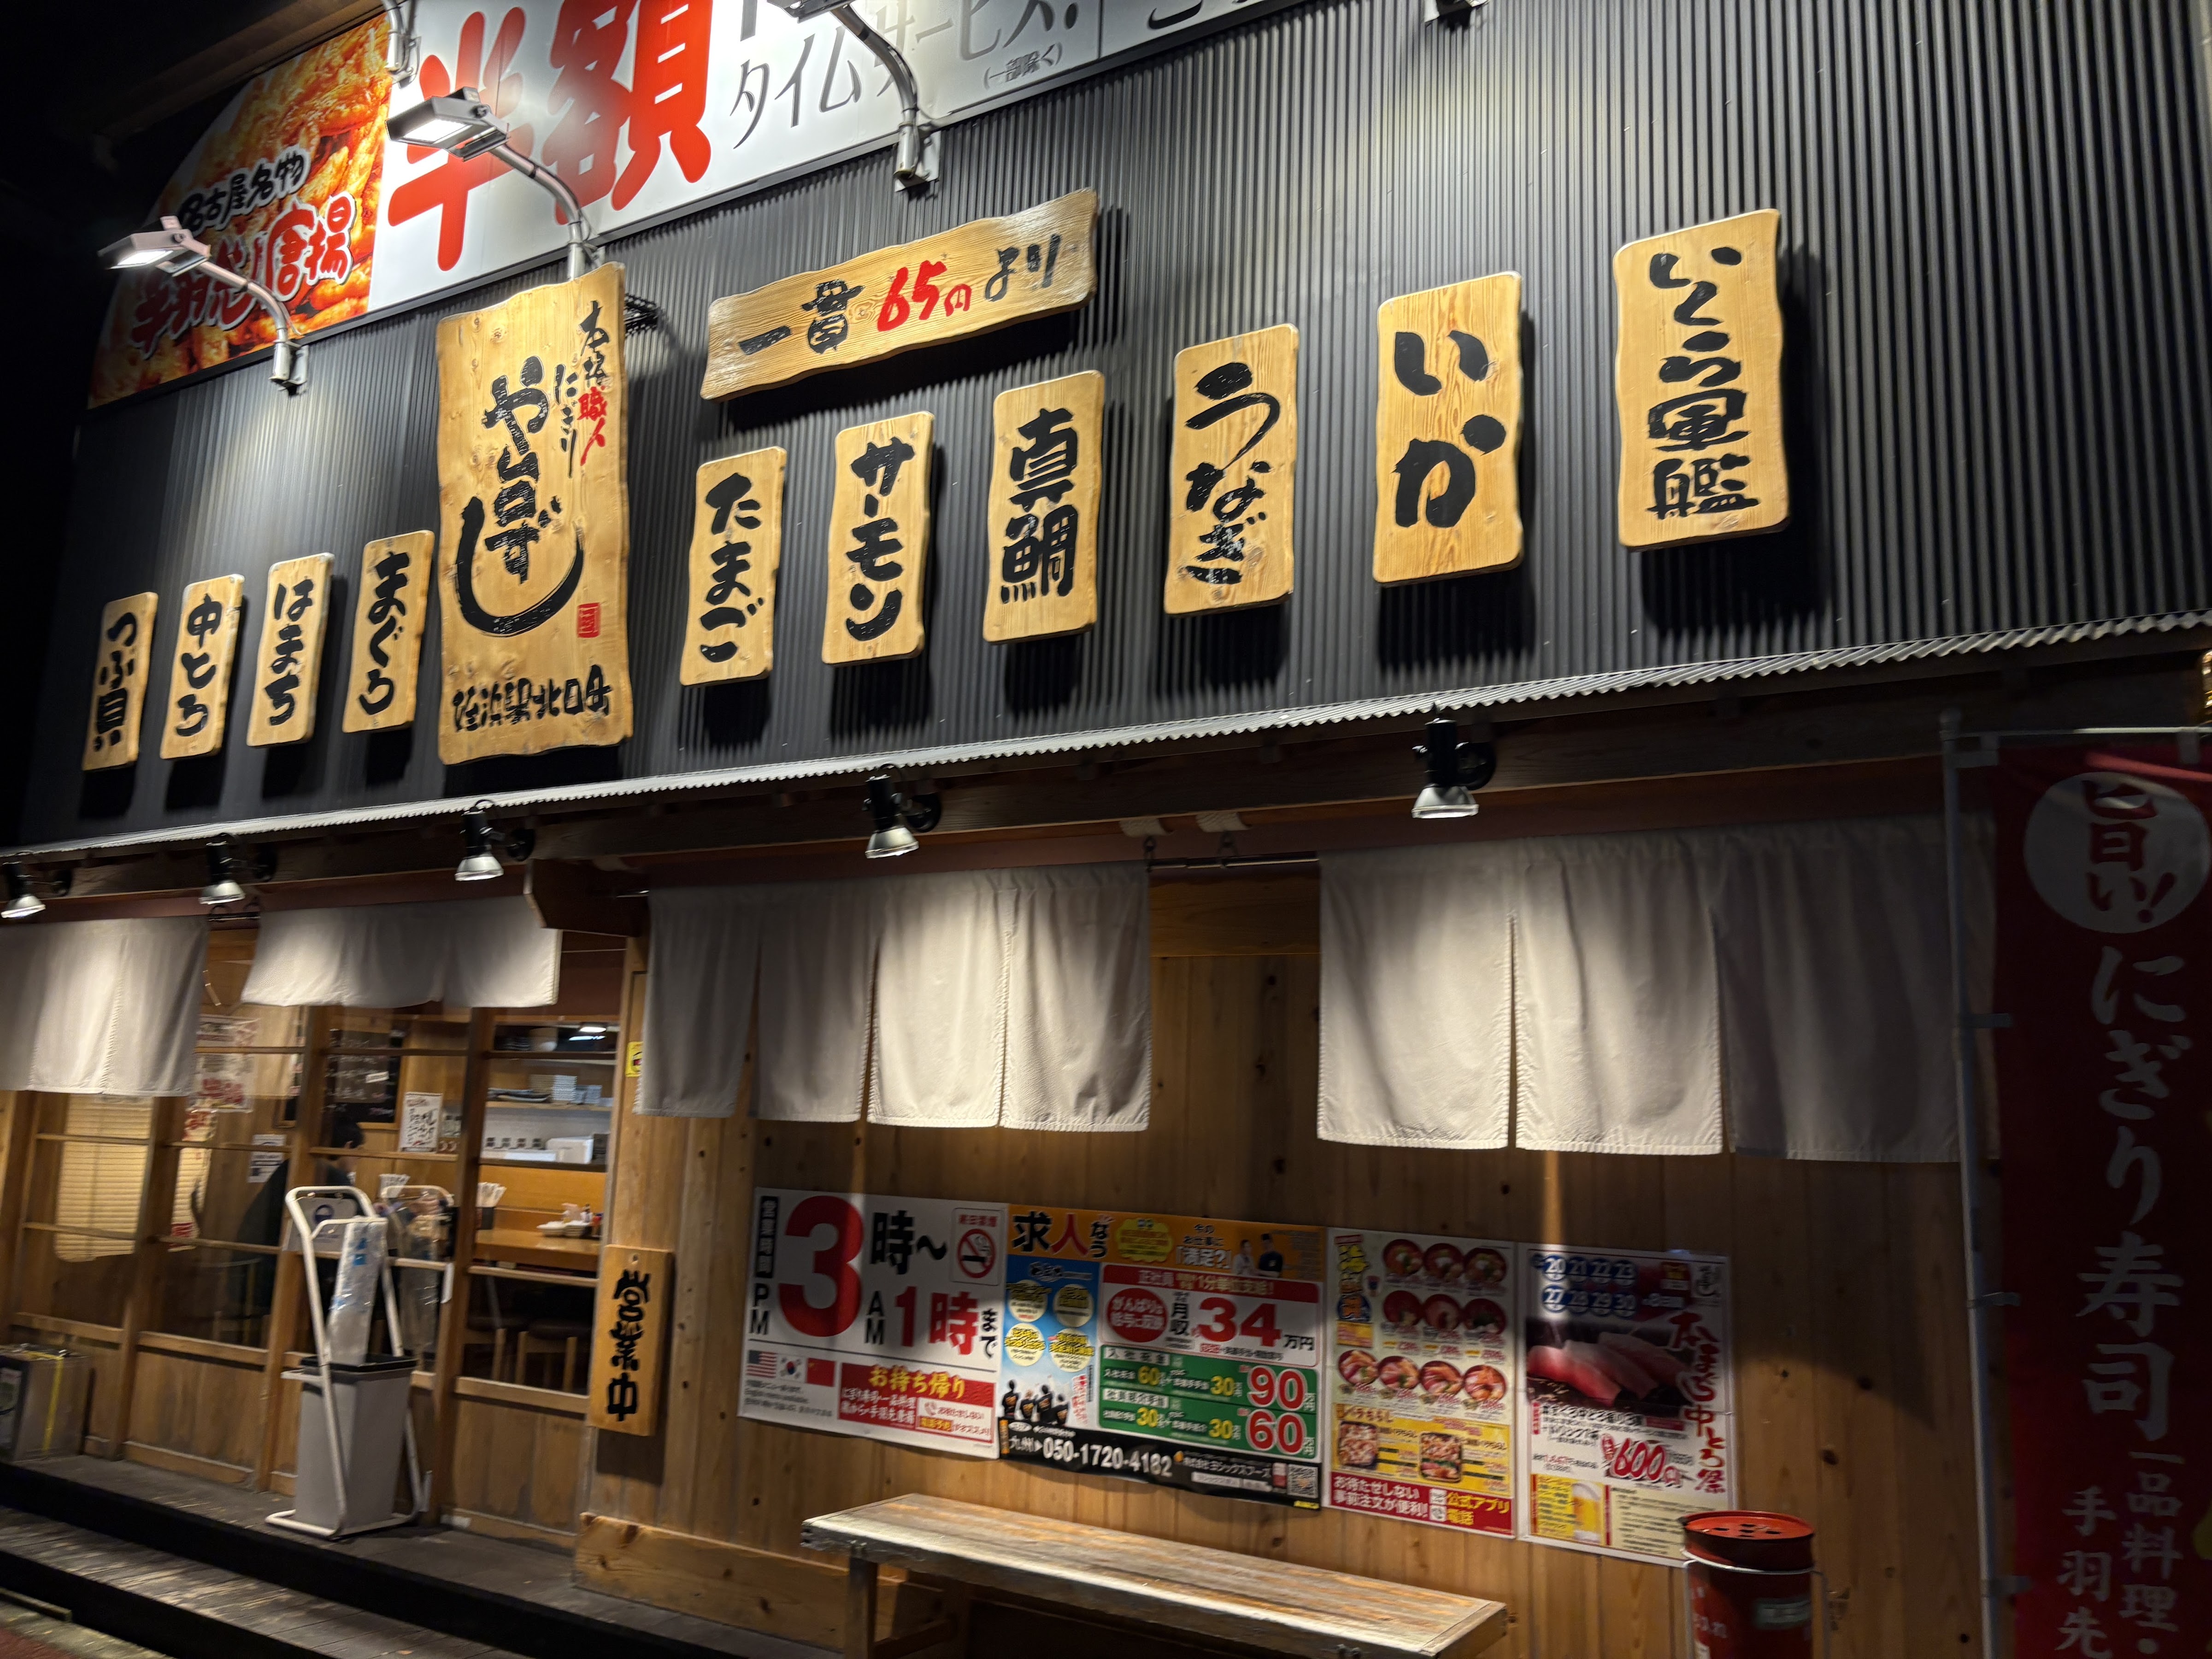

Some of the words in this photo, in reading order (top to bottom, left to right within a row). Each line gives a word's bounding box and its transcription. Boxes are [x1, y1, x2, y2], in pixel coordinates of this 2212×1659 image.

[388, 0, 712, 271] 半額
[729, 0, 1078, 149] タイムサービス
[179, 152, 306, 230] 名古屋名物
[1391, 330, 1507, 529] いか
[1645, 246, 1759, 520] いくら軍艦
[845, 436, 915, 641] サーモン
[1000, 407, 1079, 604] 真鯛
[1185, 362, 1281, 585] うなぎ
[358, 551, 411, 716] まぐろ
[700, 472, 764, 663] たまご
[94, 611, 137, 752] つぶ貝
[176, 593, 223, 737] 中とろ
[265, 576, 314, 727] はまち
[2076, 945, 2193, 1442] にぎり寿司
[607, 1269, 651, 1422] 営業中
[749, 1283, 770, 1335] PM
[865, 1291, 884, 1345] AM
[869, 1365, 966, 1399] お持ち帰り
[1042, 1436, 1173, 1477] 050-1720-4182
[2054, 1485, 2118, 1659] 手羽先
